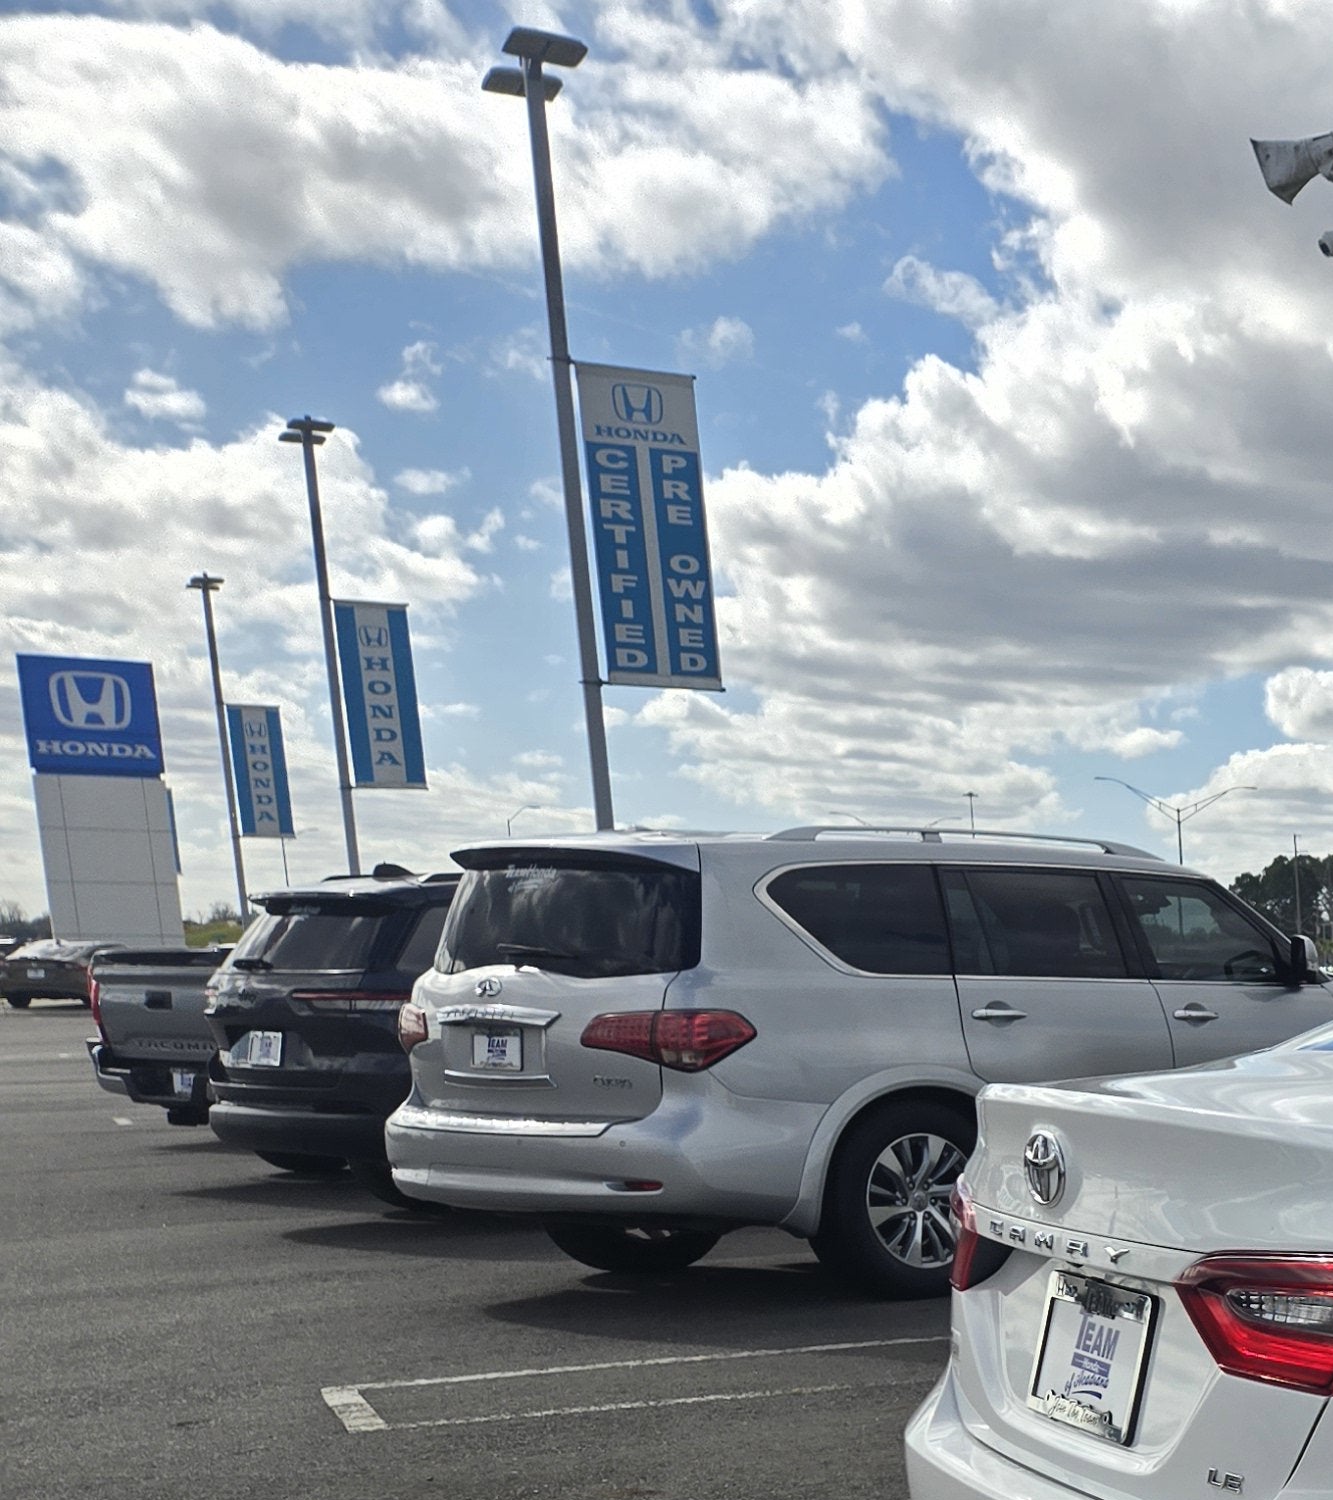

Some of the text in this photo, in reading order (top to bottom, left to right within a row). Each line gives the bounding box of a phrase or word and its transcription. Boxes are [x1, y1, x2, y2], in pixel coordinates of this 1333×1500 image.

[594, 424, 687, 446] HONDA
[594, 449, 649, 671] CERTIFIED
[660, 453, 708, 674] PRE OWNED
[363, 655, 402, 768] HONDA
[36, 738, 157, 761] HONDA
[247, 741, 276, 823] HONDA
[988, 1219, 1132, 1264] CAMRY
[1075, 1313, 1121, 1361] TEAM
[1207, 1467, 1245, 1495] LE
